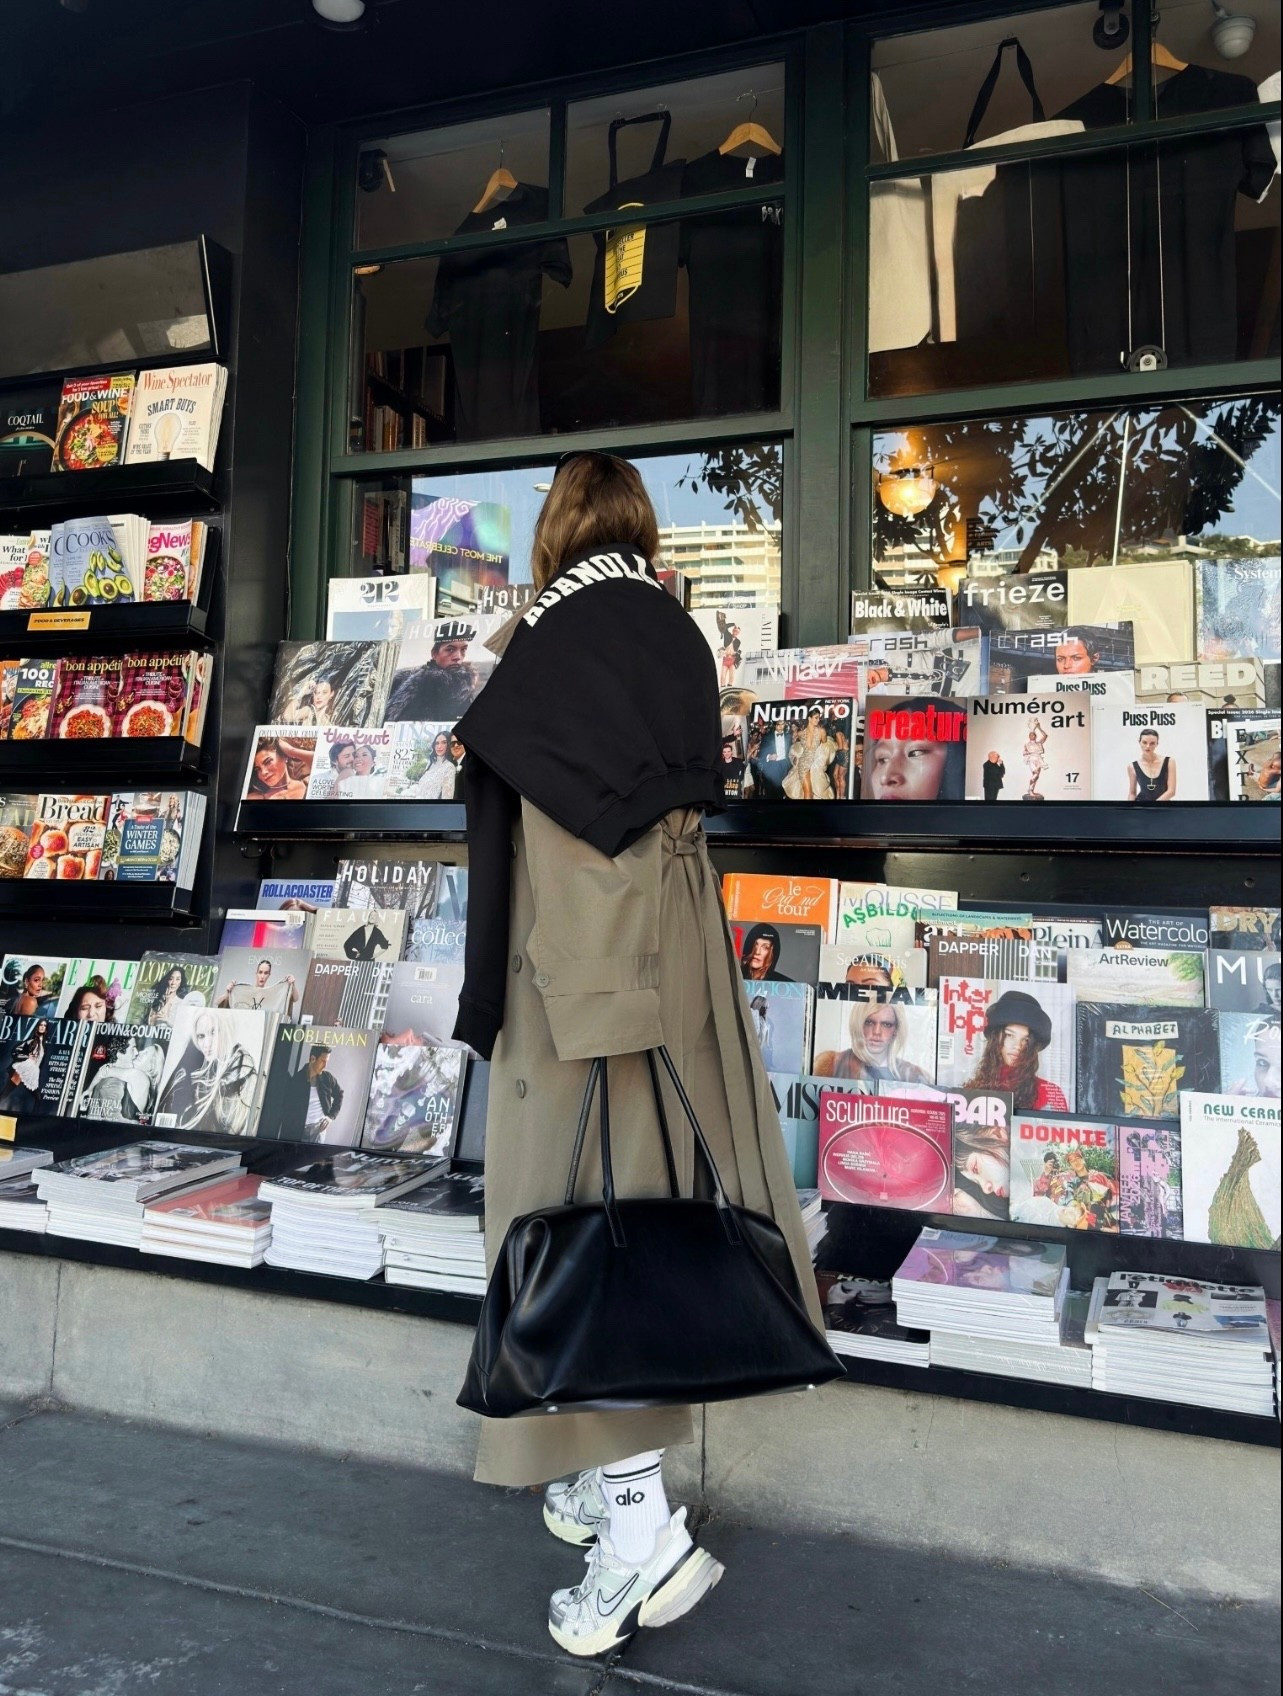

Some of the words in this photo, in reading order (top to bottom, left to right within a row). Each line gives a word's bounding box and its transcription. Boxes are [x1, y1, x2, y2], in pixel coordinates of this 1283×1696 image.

[144, 372, 167, 389] Wine
[168, 370, 213, 392] Spectator
[92, 400, 116, 414] SOUP
[147, 398, 176, 416] SMART
[176, 399, 197, 414] BUYS
[8, 413, 44, 426] COQTAIL
[2, 545, 25, 553] What
[9, 554, 24, 562] for
[360, 581, 400, 604] 212
[963, 579, 1065, 608] frieze
[855, 599, 892, 618] Black
[894, 599, 905, 617] &
[907, 597, 947, 617] White
[408, 618, 495, 641] HOLIDAY
[997, 632, 1079, 649] crash
[65, 662, 86, 672] bon
[87, 660, 123, 675] appéti
[128, 658, 147, 667] bon
[148, 654, 187, 670] appétit
[22, 668, 46, 681] 100
[1141, 662, 1257, 690] REED
[1056, 681, 1081, 694] Puss
[1082, 680, 1107, 695] Puss
[973, 697, 1064, 716] Numéro
[869, 704, 967, 742] creatur
[1051, 712, 1085, 728] art
[1122, 711, 1148, 727] Puss
[1149, 710, 1176, 727] Puss
[323, 728, 353, 746] the
[353, 729, 391, 746] knot
[1065, 773, 1080, 783] 17
[311, 790, 354, 798] CELEBRATING
[41, 797, 108, 821] Bread
[126, 830, 158, 840] WINTER
[125, 840, 157, 850] GAMES
[341, 865, 433, 884] HOLIDAY
[262, 884, 333, 899] ROLLACOASTER
[788, 881, 802, 896] le
[777, 904, 811, 916] tour
[1217, 911, 1279, 934] DRY
[1106, 919, 1208, 944] Watercolo
[938, 940, 1000, 956] DAPPER
[1018, 945, 1052, 959] DAN
[1099, 953, 1169, 968] ArtReview
[68, 959, 137, 989] ELLE
[139, 961, 215, 987] L'OFCIEL
[315, 963, 360, 978] DAPPER
[410, 993, 433, 1005] cara
[818, 981, 935, 1006] METAL
[0, 1015, 76, 1047] BAZAR
[281, 1028, 368, 1048] NOBLEMAN
[1112, 1024, 1176, 1036] ALPHABET
[87, 1097, 101, 1107] THE
[428, 1097, 450, 1113] AN
[1203, 1103, 1234, 1116] NEW
[425, 1112, 448, 1125] OTH
[826, 1100, 909, 1127] sculpture
[1216, 1117, 1254, 1125] International
[432, 1124, 447, 1133] ER
[1019, 1123, 1107, 1148] DONNIE
[278, 1177, 305, 1186] TOP
[305, 1182, 321, 1190] OF
[324, 1185, 348, 1193] THE
[836, 1274, 892, 1288] HOM
[616, 1487, 645, 1506] alo
